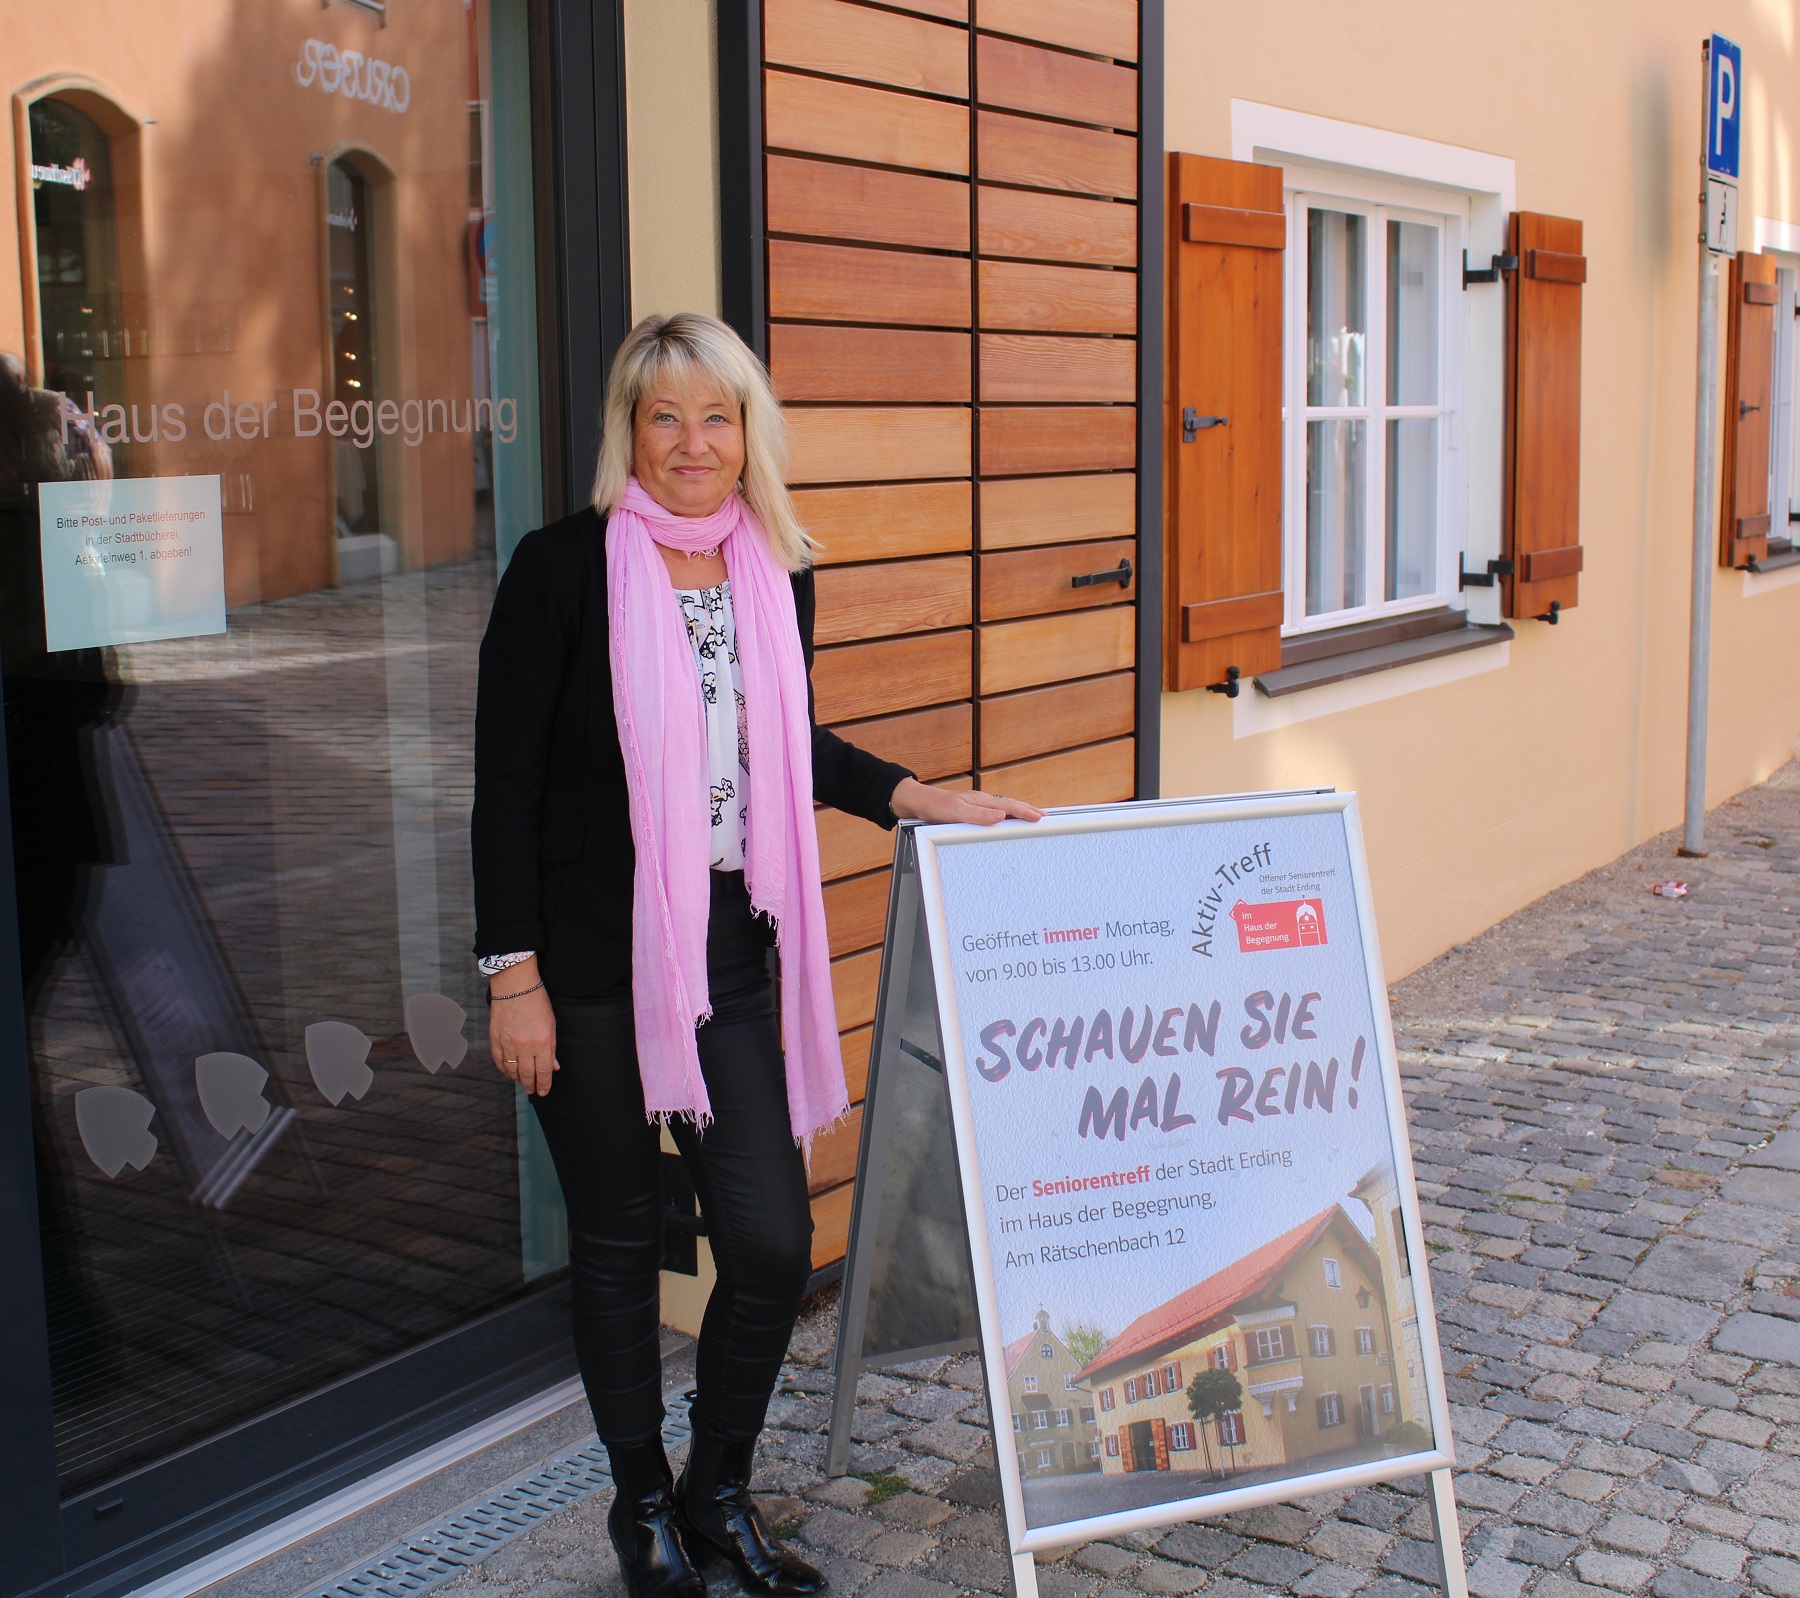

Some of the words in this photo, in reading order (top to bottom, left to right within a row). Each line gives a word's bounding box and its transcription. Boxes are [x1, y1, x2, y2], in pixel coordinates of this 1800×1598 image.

[1715, 54, 1735, 156] P
[60, 390, 188, 444] Haus
[203, 389, 277, 441] der
[293, 388, 518, 449] Begegnung
[56, 517, 79, 529] Bitte
[81, 515, 107, 527] Post-
[109, 514, 127, 525] und
[129, 510, 206, 524] Paketlieferungen
[85, 534, 94, 546] in
[97, 533, 113, 545] der
[114, 530, 181, 544] Stadtbücherei,
[139, 550, 148, 562] 1,
[150, 546, 193, 561] abgeben!
[1259, 873, 1287, 883] Offener
[1288, 868, 1336, 881] Seniorentreff
[1261, 886, 1274, 895] der
[1275, 884, 1295, 894] Stadt
[1297, 882, 1321, 892] Erding
[1191, 842, 1272, 958] Aktiv-Treff
[1241, 911, 1253, 920] im
[962, 930, 1040, 952] Geöffnet
[1043, 926, 1100, 944] immer
[1105, 918, 1176, 939] Montag,
[1243, 924, 1264, 932] Haus
[1265, 922, 1278, 930] der
[1245, 934, 1290, 946] Begegnung
[965, 967, 998, 983] von
[1002, 961, 1038, 981] 9.00
[1042, 957, 1067, 976] bis
[1071, 953, 1116, 973] 13.00
[1120, 949, 1154, 968] Uhr.
[975, 999, 1221, 1083] SCHAUEN
[1240, 989, 1322, 1050] SIE
[1077, 1072, 1197, 1142] MAL
[1215, 1035, 1366, 1126] REIN!
[996, 1184, 1028, 1202] Der
[1032, 1165, 1151, 1197] Seniorentreff
[1155, 1163, 1184, 1181] der
[1188, 1154, 1235, 1176] Stadt
[1239, 1148, 1293, 1170] Erding
[1000, 1216, 1023, 1234] im
[1028, 1209, 1073, 1230] Haus
[1077, 1203, 1107, 1223] der
[1112, 1191, 1217, 1220] Begegnung,
[1005, 1250, 1035, 1269] Am
[1040, 1230, 1160, 1264] Rätschenbach
[1165, 1227, 1186, 1246] 12
